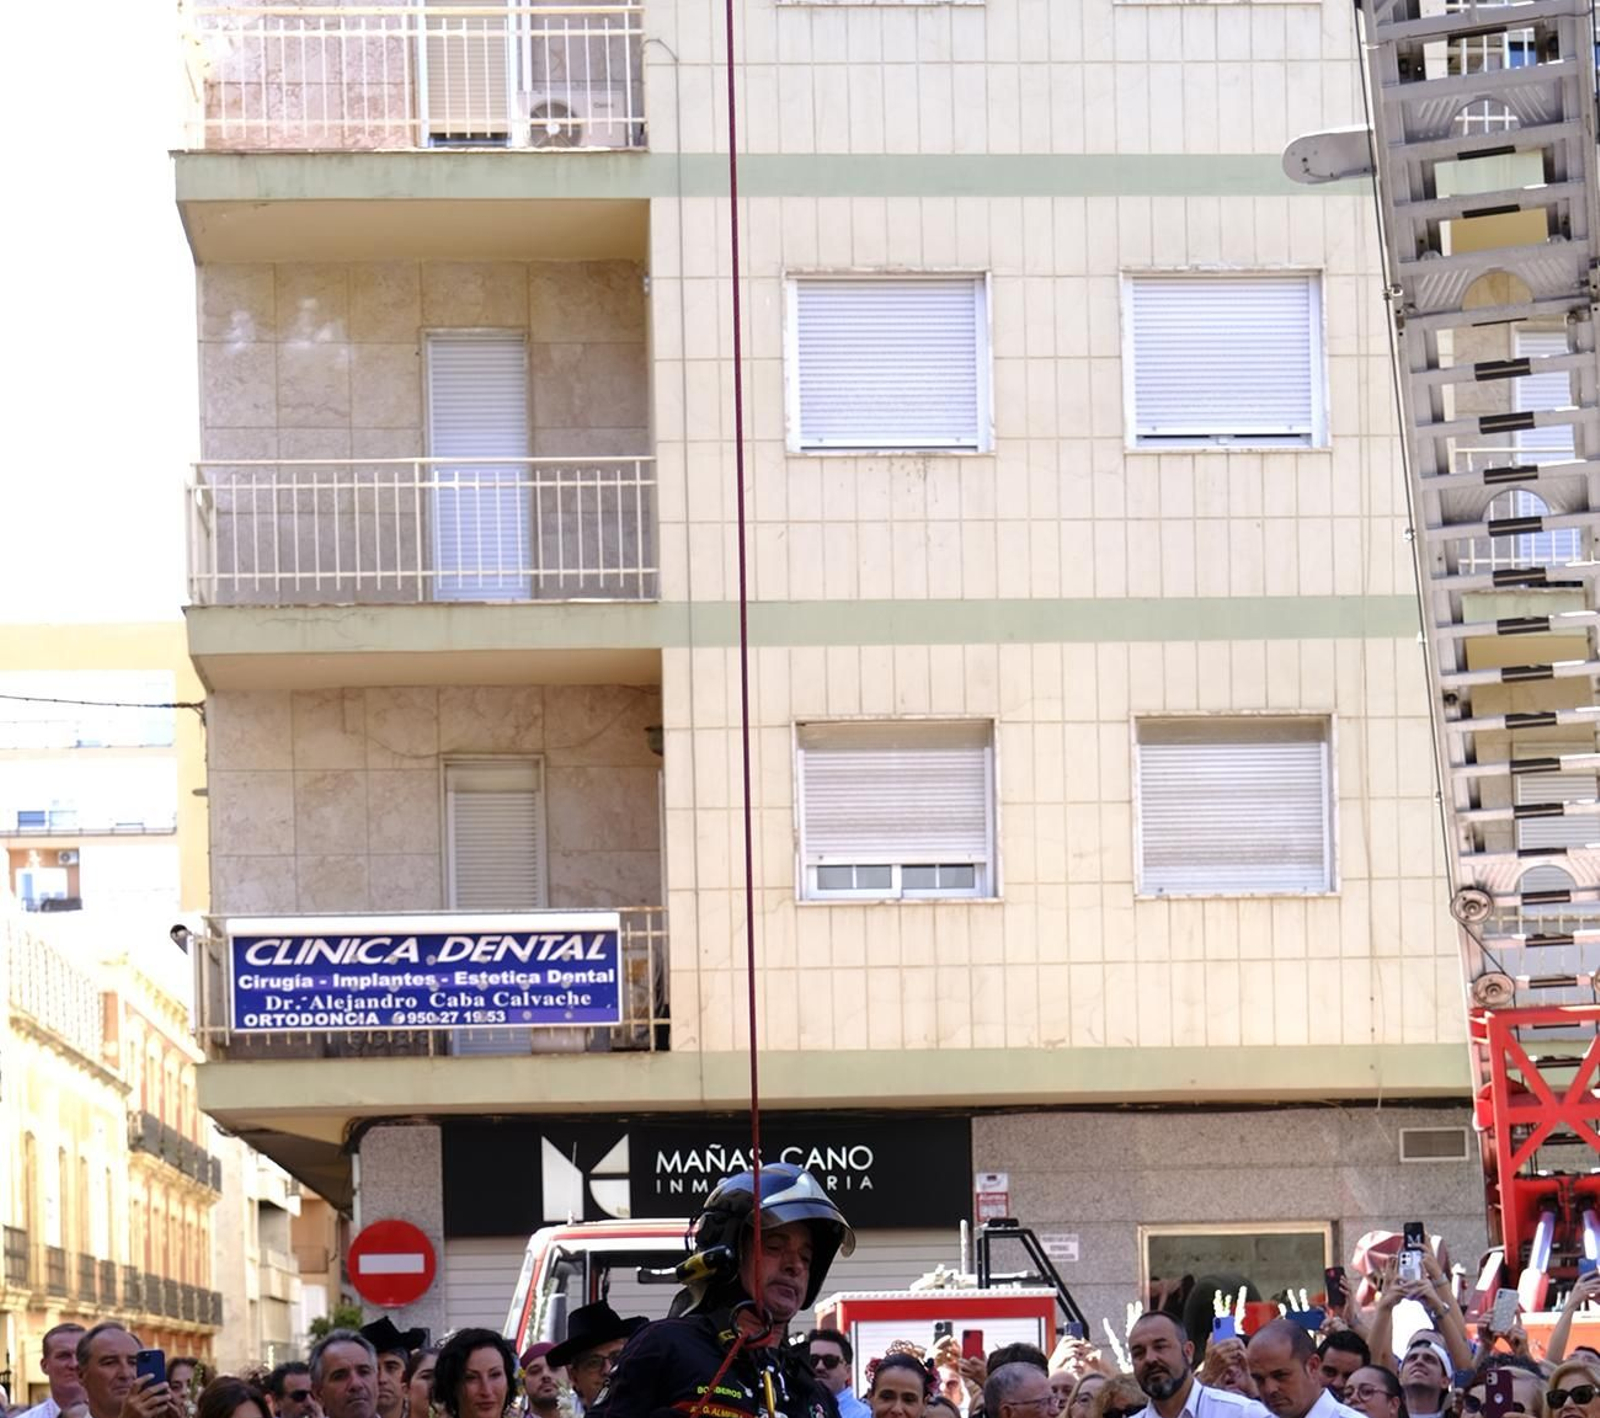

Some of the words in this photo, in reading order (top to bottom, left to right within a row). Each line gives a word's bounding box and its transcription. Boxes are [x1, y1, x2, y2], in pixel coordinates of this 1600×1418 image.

[244, 936, 420, 967] CLINICA
[436, 933, 608, 963] DENTAL
[332, 971, 437, 990] Implantes
[546, 967, 615, 984] Dental
[308, 992, 418, 1013] Alejandro
[428, 991, 486, 1008] Caba
[491, 989, 593, 1007] Calvache
[242, 1012, 381, 1027] ORTODONCIA
[655, 1144, 764, 1173] MAÑAS
[779, 1145, 875, 1171] CANO
[697, 1386, 742, 1399] BOBEROS
